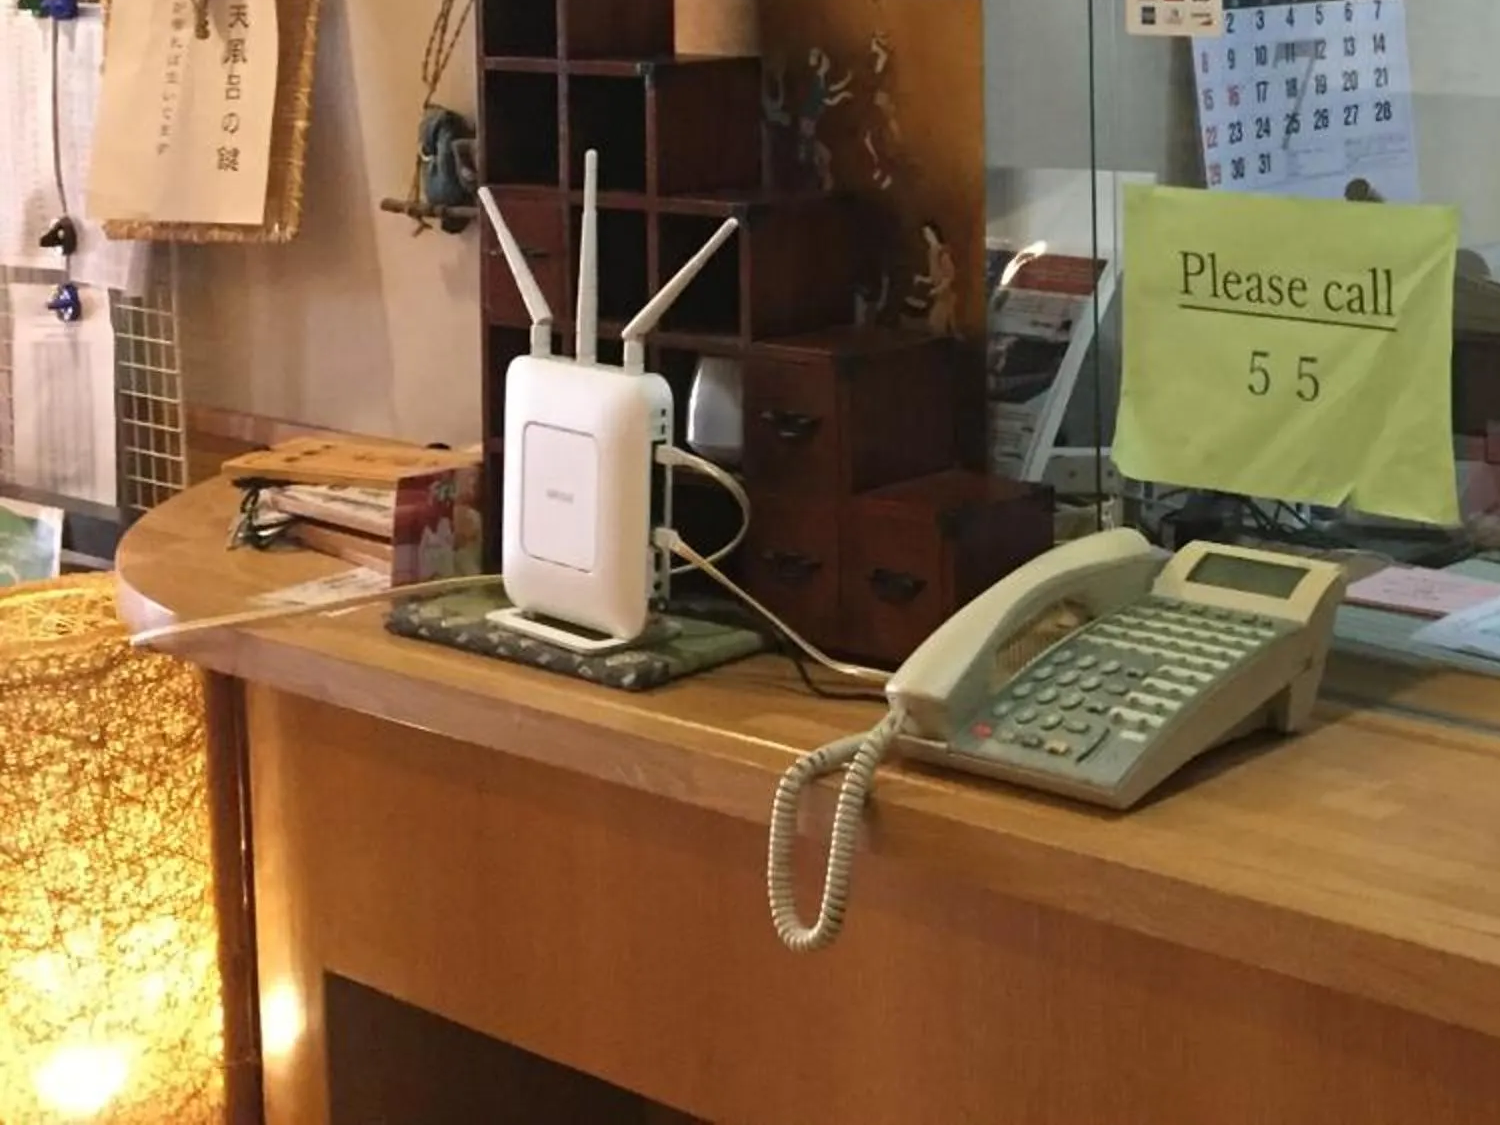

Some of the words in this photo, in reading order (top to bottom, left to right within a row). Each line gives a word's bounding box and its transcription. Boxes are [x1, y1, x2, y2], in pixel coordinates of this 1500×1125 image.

[1225, 13, 1235, 33] 2
[1256, 10, 1264, 30] 3
[1285, 7, 1294, 27] 4
[1315, 5, 1324, 25] 5
[1344, 2, 1352, 21] 6
[1373, 0, 1381, 19] 7
[1227, 49, 1235, 69] 9
[1254, 45, 1267, 66] 10
[1313, 39, 1326, 59] 12
[1343, 36, 1356, 56] 13
[1373, 34, 1385, 54] 14
[1256, 82, 1269, 103] 17
[1314, 75, 1327, 95] 19
[1342, 71, 1358, 92] 20
[1374, 68, 1388, 88] 21
[1228, 122, 1243, 144] 23
[1256, 118, 1271, 139] 24
[1284, 114, 1300, 135] 25
[1313, 110, 1329, 130] 26
[1343, 105, 1359, 126] 27
[1375, 101, 1392, 122] 28
[1231, 159, 1245, 180] 30
[1259, 154, 1272, 174] 31
[1178, 250, 1308, 308] Please
[1323, 268, 1397, 317] call
